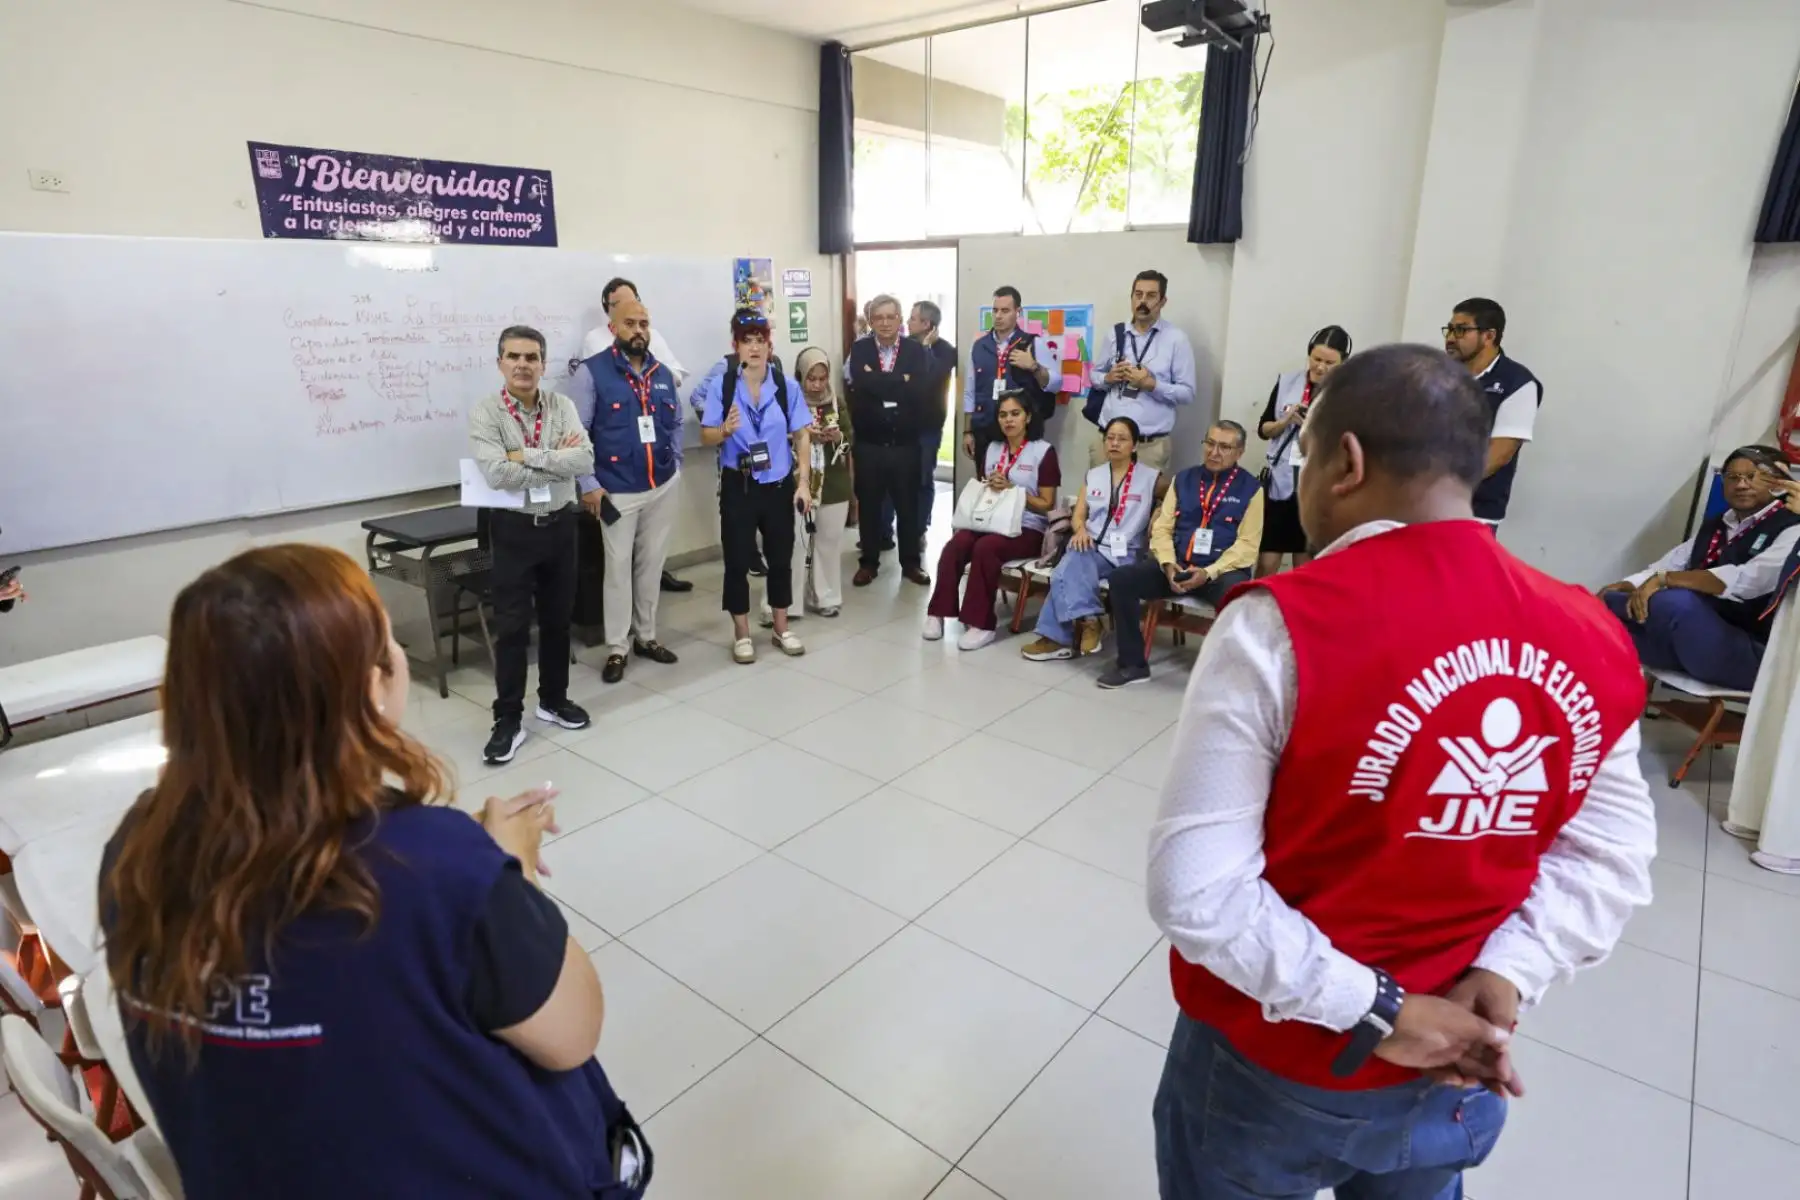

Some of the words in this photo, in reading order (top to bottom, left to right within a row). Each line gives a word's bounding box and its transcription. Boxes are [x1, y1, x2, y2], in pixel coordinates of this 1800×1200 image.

[295, 154, 525, 205] ¡Bienvenidas!
[284, 217, 297, 229] a
[304, 214, 323, 230] la
[456, 224, 467, 239] y
[470, 221, 484, 237] el
[407, 202, 467, 221] alegres
[471, 205, 543, 223] cantemos
[1347, 702, 1423, 802] JURADO
[1405, 637, 1514, 714] NACIONAL
[1517, 642, 1549, 686] DE
[1418, 795, 1540, 834] JNE
